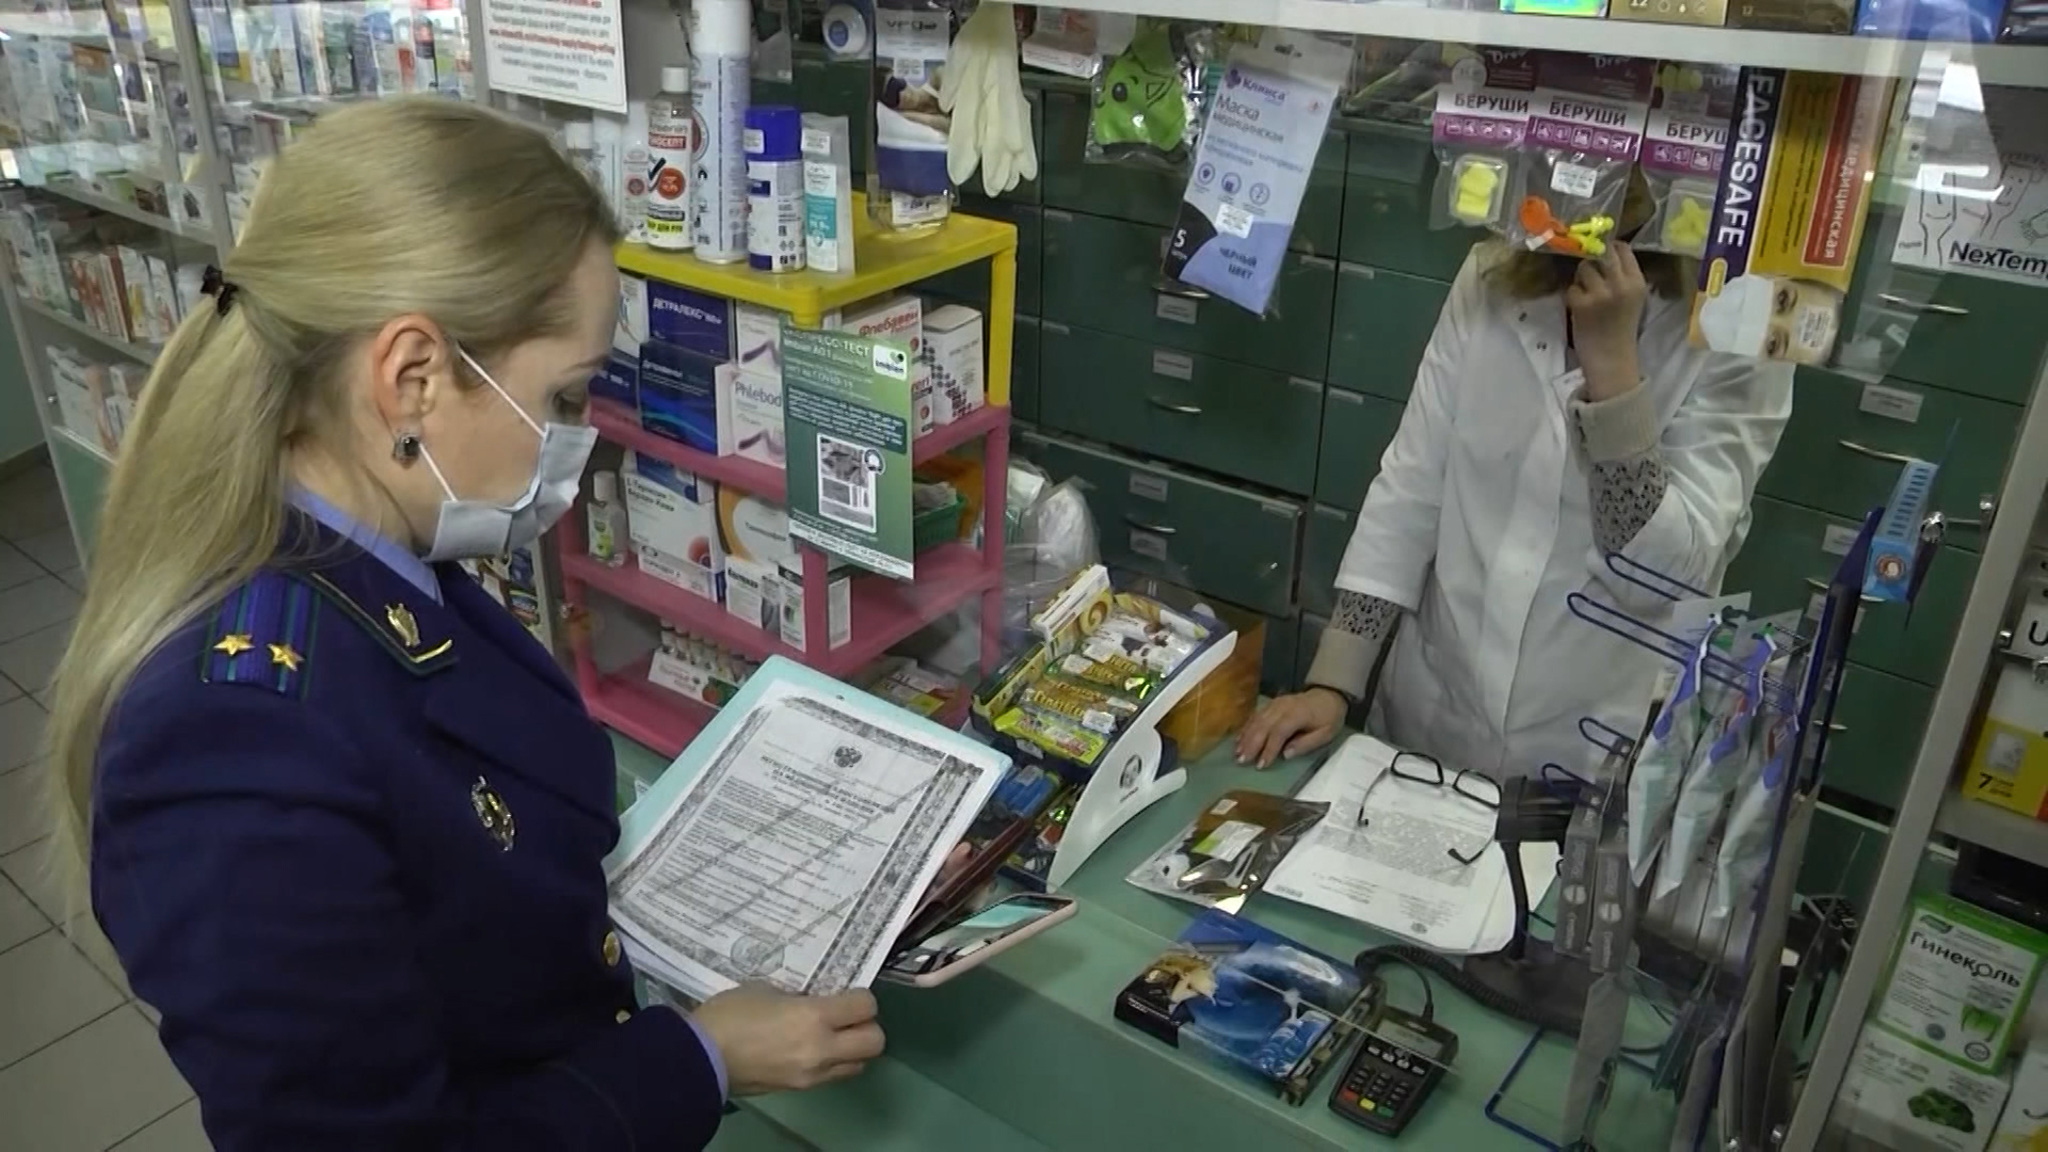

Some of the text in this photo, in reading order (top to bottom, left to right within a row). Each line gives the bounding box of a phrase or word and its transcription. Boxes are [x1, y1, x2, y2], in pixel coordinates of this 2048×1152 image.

[1454, 92, 1529, 113] БЕРУШИ
[1549, 101, 1627, 127] БЕРУШИ
[1717, 73, 1776, 248] FACESAFE
[1174, 228, 1187, 248] 5
[1948, 240, 2048, 280] NexTem
[1910, 931, 2021, 988] Гинеколь
